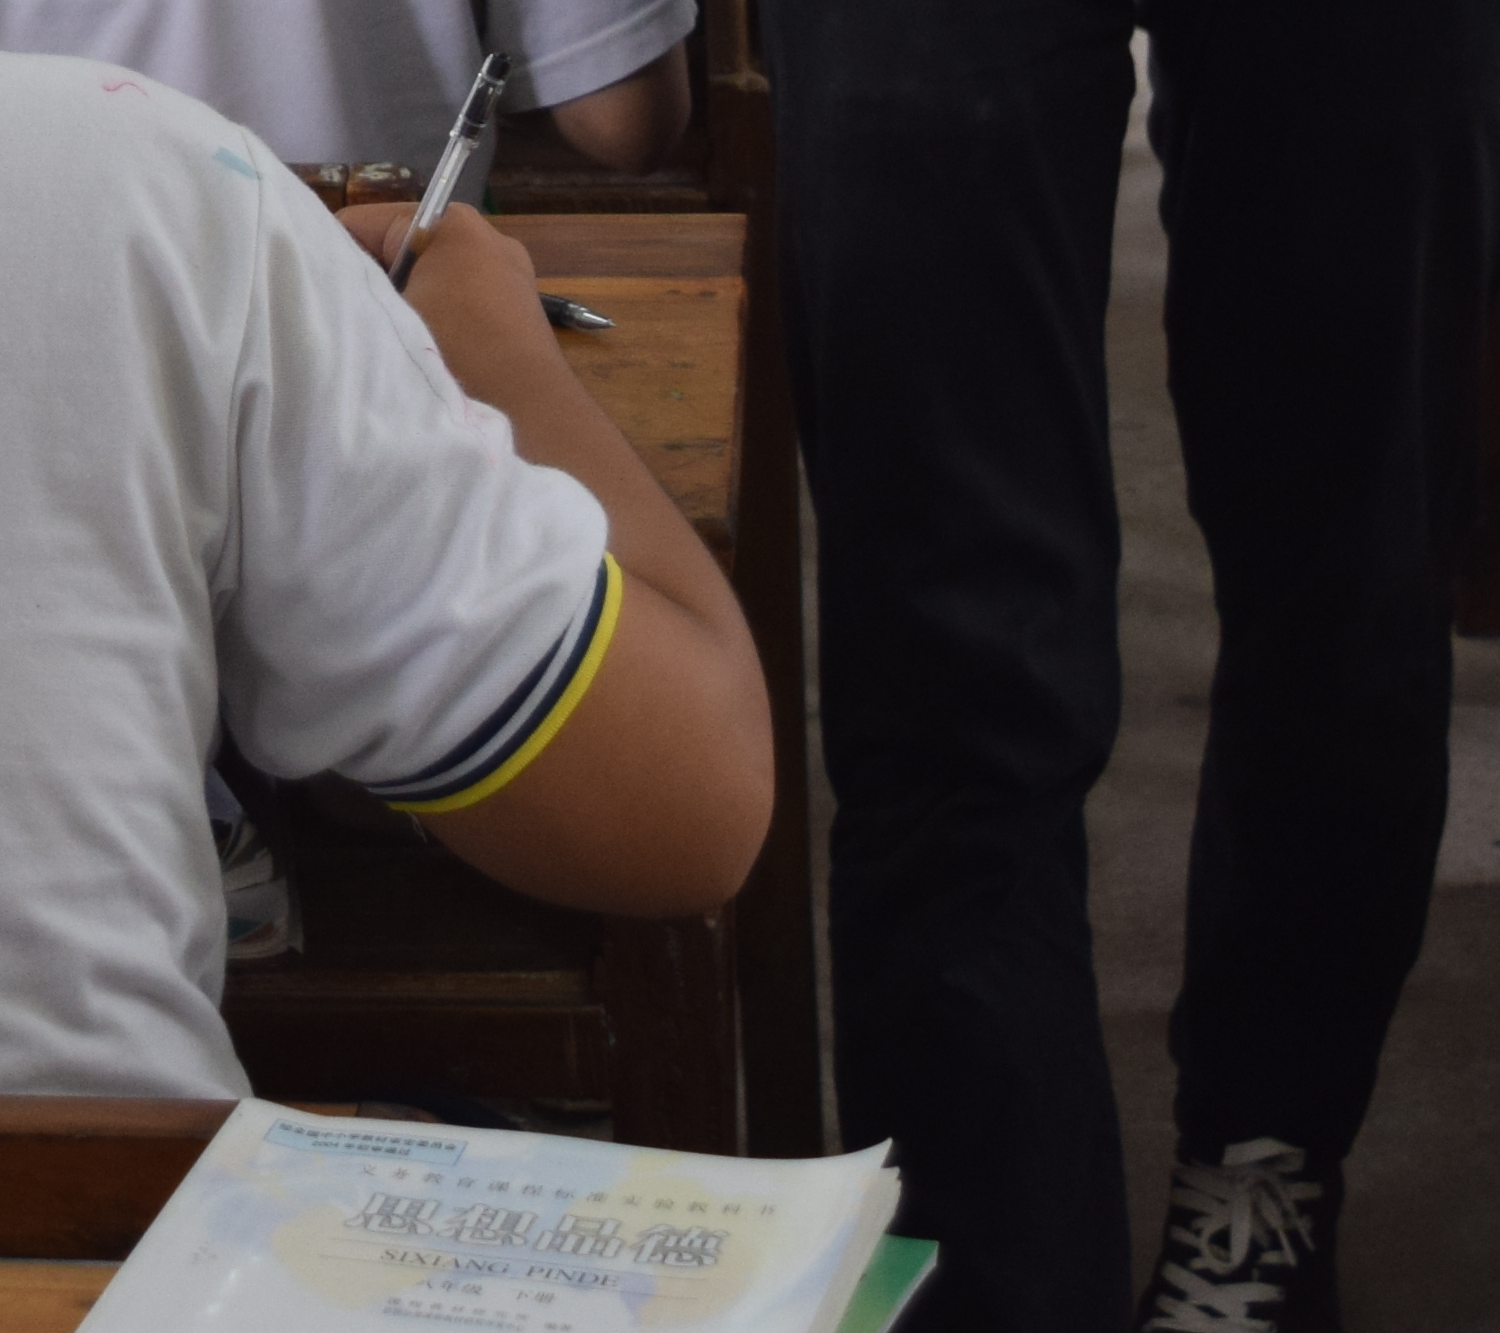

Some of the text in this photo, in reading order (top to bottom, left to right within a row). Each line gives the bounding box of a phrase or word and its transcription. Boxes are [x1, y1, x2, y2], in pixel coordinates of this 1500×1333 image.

[358, 1165, 778, 1217] 义务教育课程标准实验教科书
[344, 1192, 731, 1269] 思想品德
[380, 1247, 624, 1289] SIXIANG PINDE
